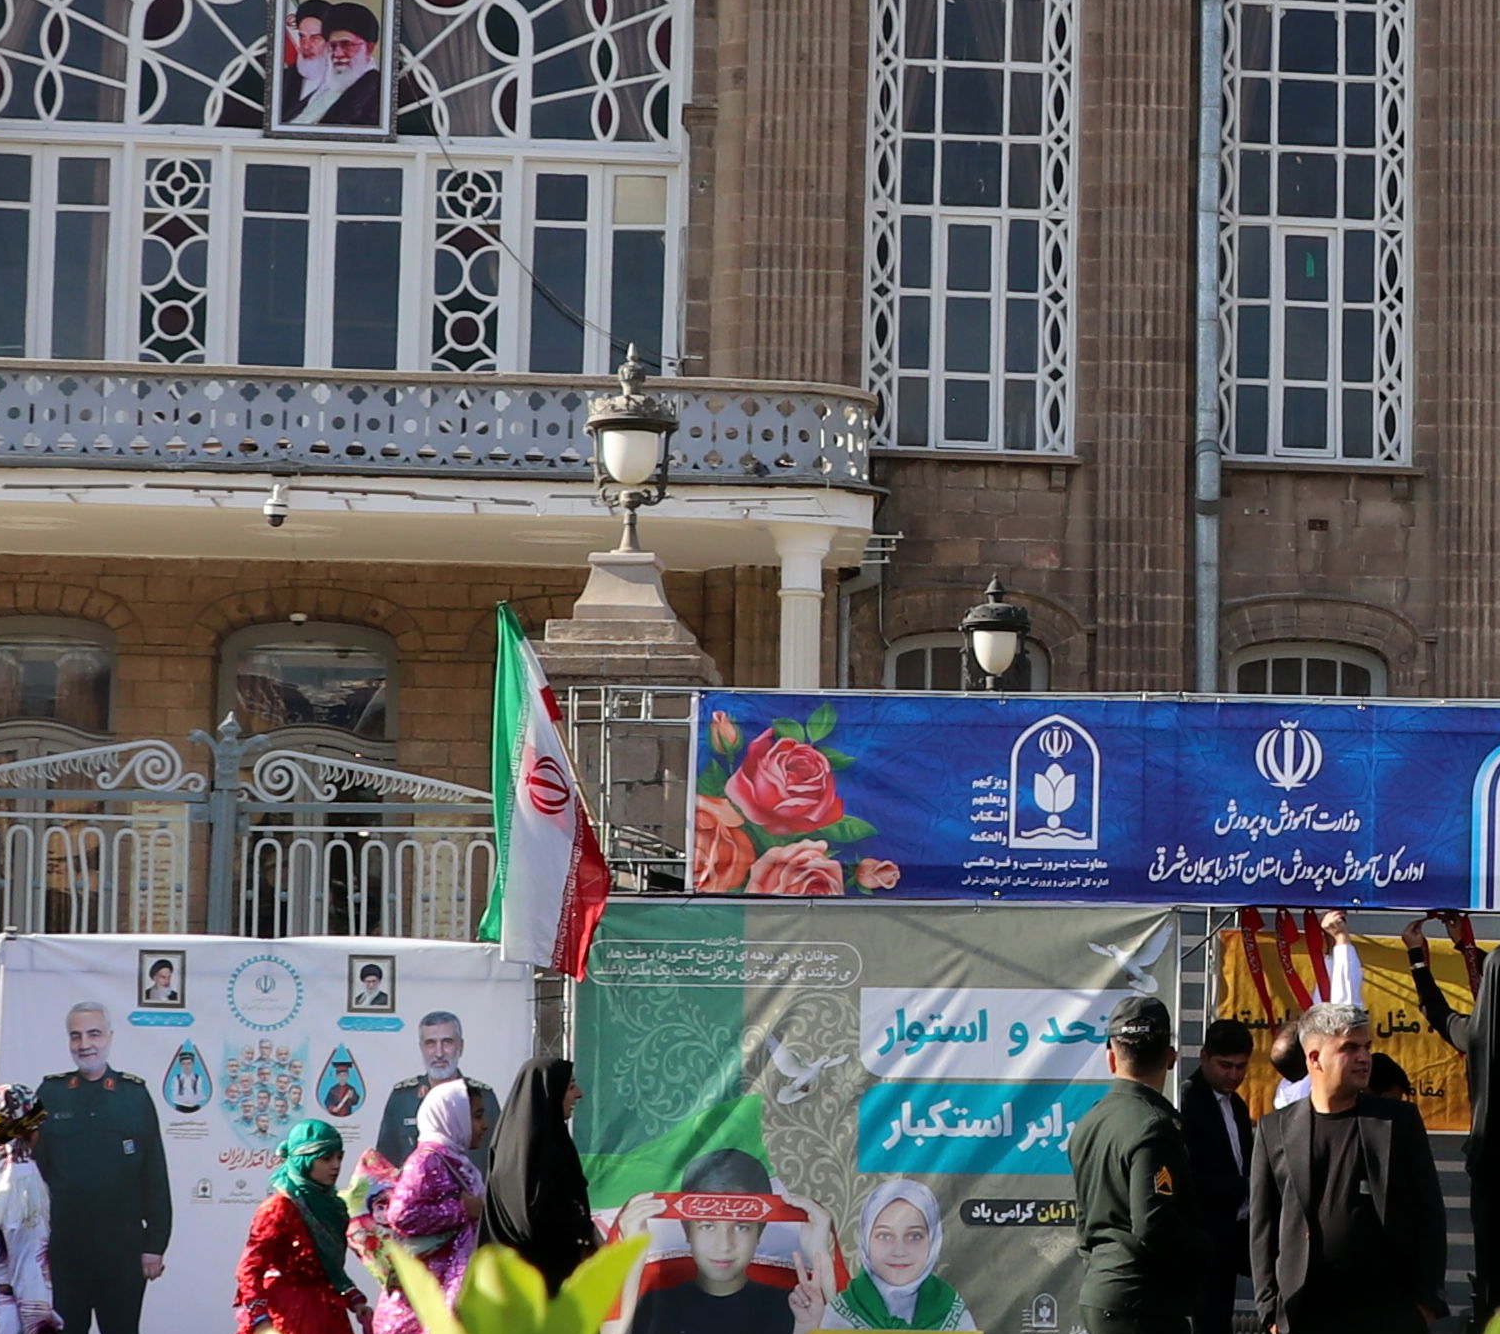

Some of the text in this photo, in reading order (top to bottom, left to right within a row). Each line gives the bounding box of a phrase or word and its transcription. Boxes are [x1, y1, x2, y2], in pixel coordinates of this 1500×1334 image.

[1214, 798, 1361, 842] وزارت آموزش و پرورش
[1149, 844, 1425, 892] اداره کل آموزش و پرورش استان آذربایجان شرقی
[655, 948, 697, 964] کشورها
[696, 950, 723, 965] تاریخ
[723, 949, 734, 964] از
[775, 951, 790, 965] هر
[791, 952, 803, 963] در
[804, 950, 839, 966] جوانان
[593, 964, 626, 978] باشند
[672, 966, 710, 976] سعادت
[711, 965, 737, 981] مراکز
[739, 966, 779, 981] مهمترین
[807, 966, 837, 981] توانند
[838, 970, 851, 981] می
[1376, 1008, 1420, 1040] مثل
[877, 1008, 987, 1057] استوار
[1008, 1021, 1029, 1057] و
[882, 1100, 1013, 1151] استکبار
[971, 1201, 992, 1220] باد
[993, 1202, 1036, 1224] گرامی
[1036, 1201, 1068, 1224] آبان
